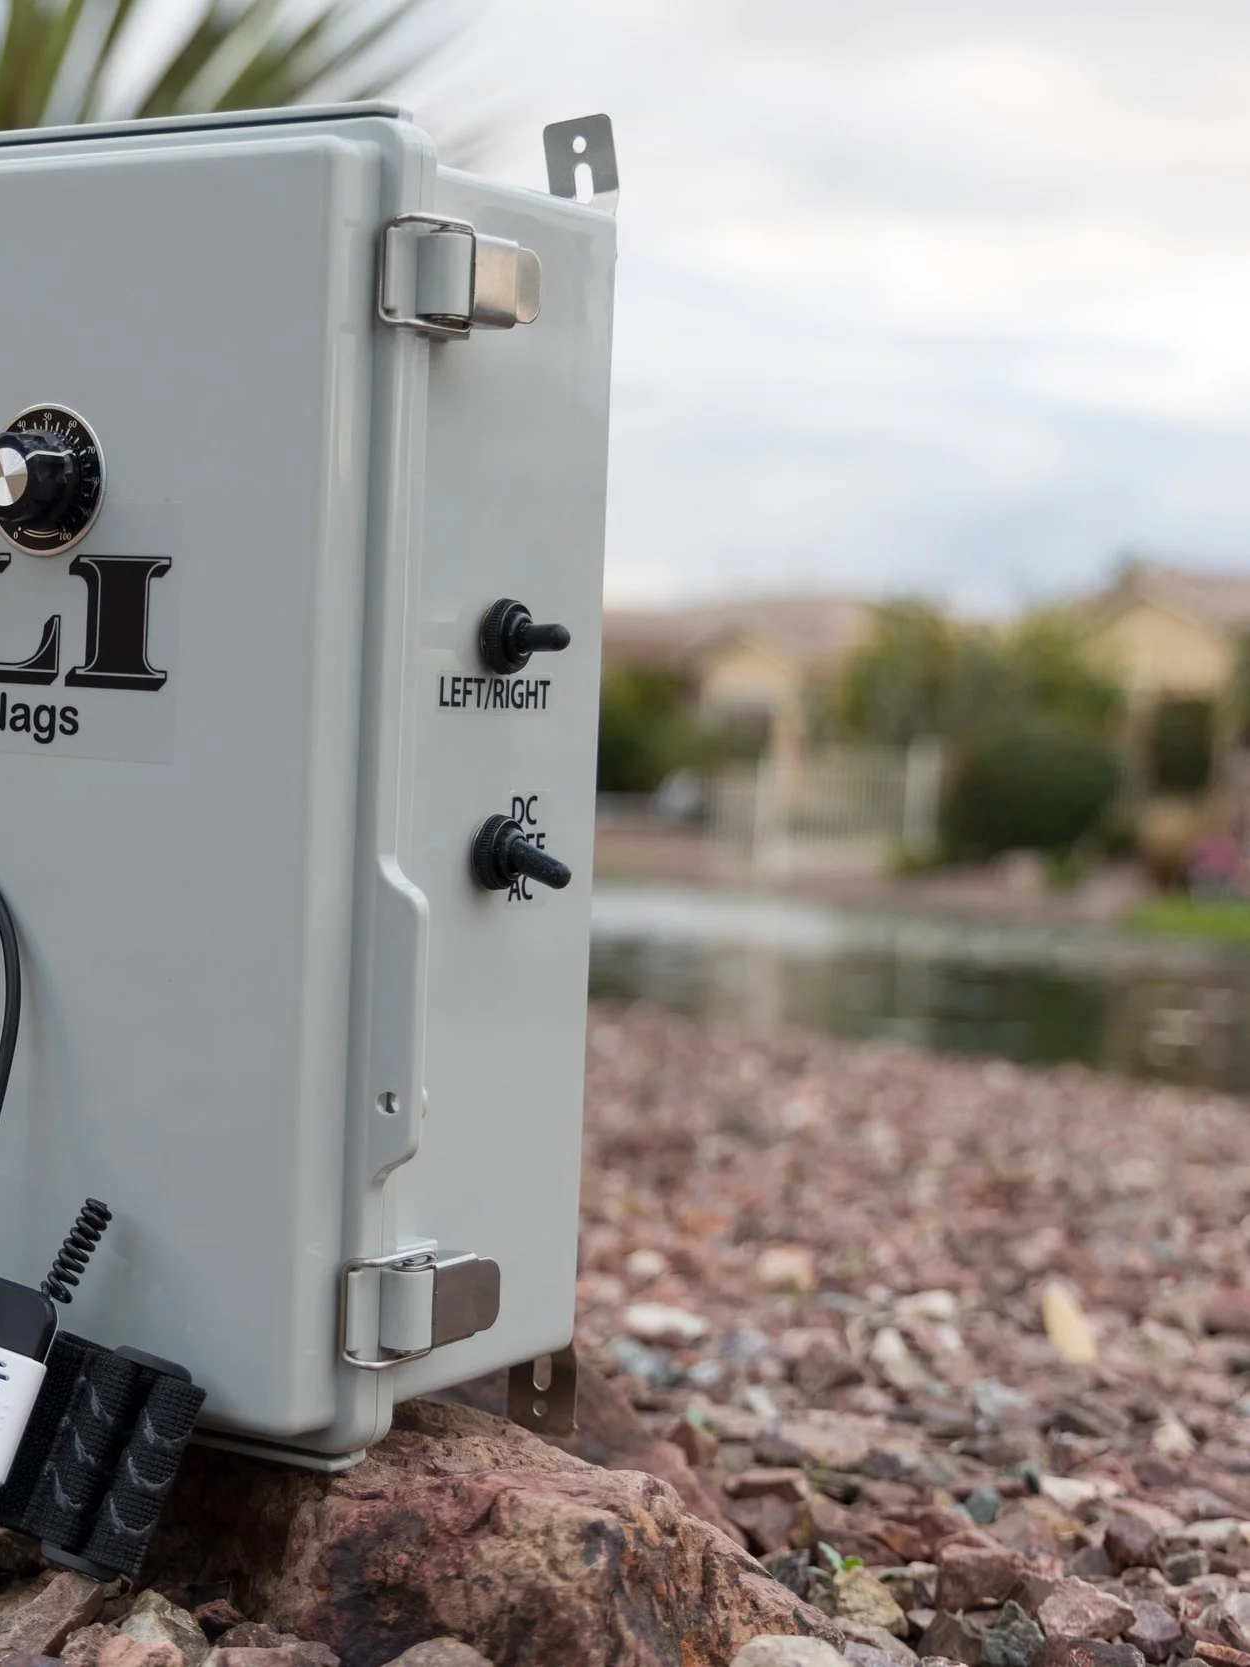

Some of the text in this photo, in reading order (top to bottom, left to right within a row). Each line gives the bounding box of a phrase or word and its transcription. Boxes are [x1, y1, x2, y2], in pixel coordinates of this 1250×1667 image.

[43, 412, 53, 421] 50
[17, 420, 27, 429] 40
[68, 420, 77, 428] 60
[87, 446, 96, 454] 70
[59, 532, 72, 541] 100
[439, 676, 551, 710] LEFT/RIGHT
[511, 795, 539, 825] DC
[507, 875, 533, 902] AC
